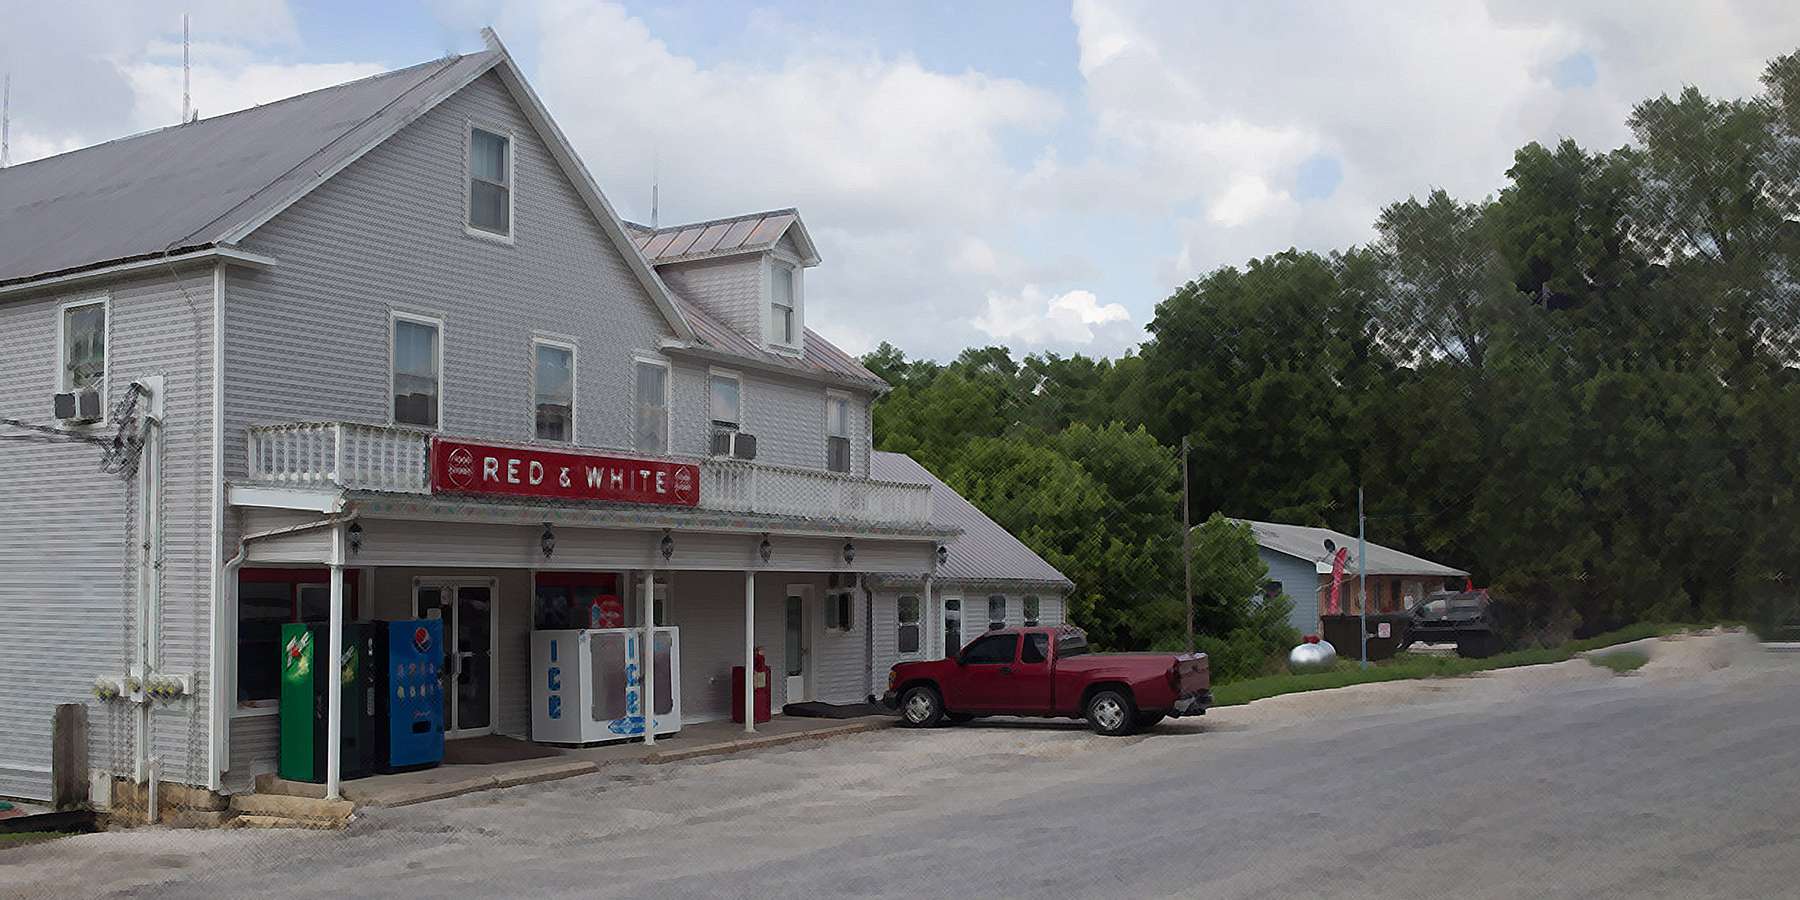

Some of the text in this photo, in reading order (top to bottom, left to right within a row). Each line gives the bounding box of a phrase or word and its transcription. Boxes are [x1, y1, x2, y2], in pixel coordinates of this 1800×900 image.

[483, 456, 667, 494] RED & WHITE
[548, 639, 561, 720] ICE
